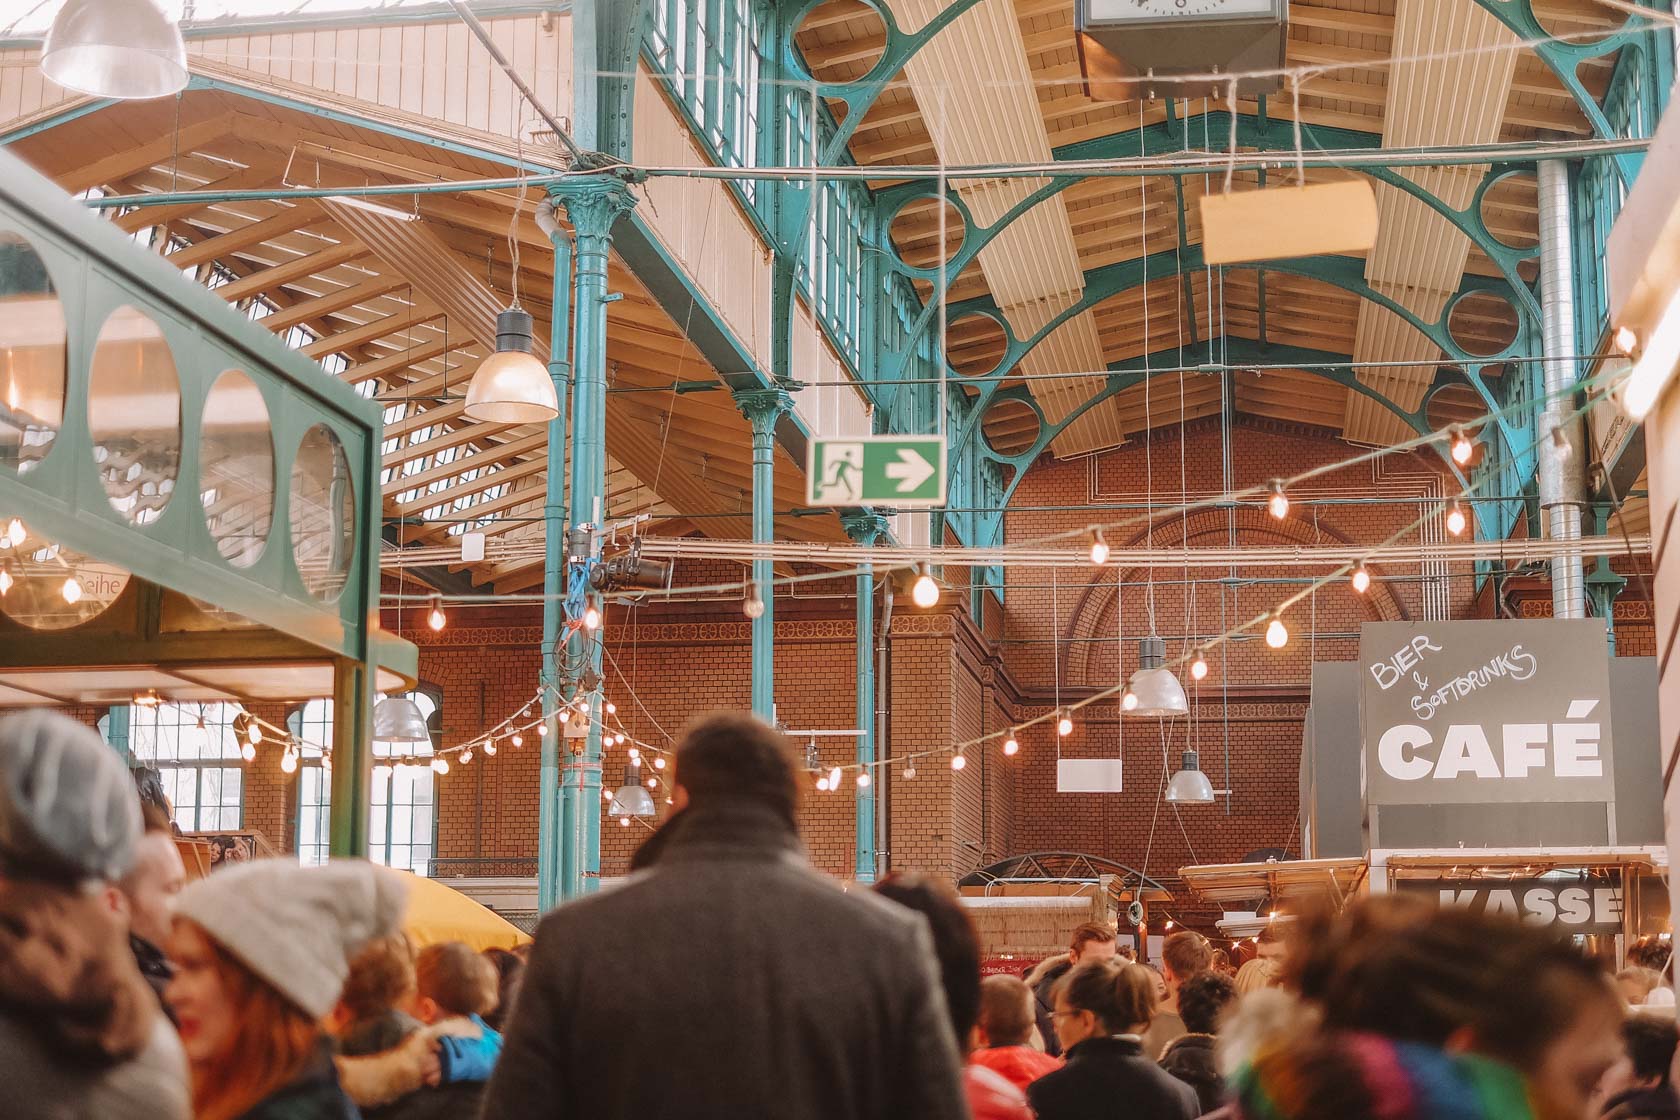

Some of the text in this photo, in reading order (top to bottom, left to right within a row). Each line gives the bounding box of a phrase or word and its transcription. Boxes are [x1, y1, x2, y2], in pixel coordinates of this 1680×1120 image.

[76, 574, 121, 594] Reihe
[1370, 635, 1442, 690] BIER
[1413, 671, 1429, 691] &
[1378, 700, 1603, 780] CAFÉ
